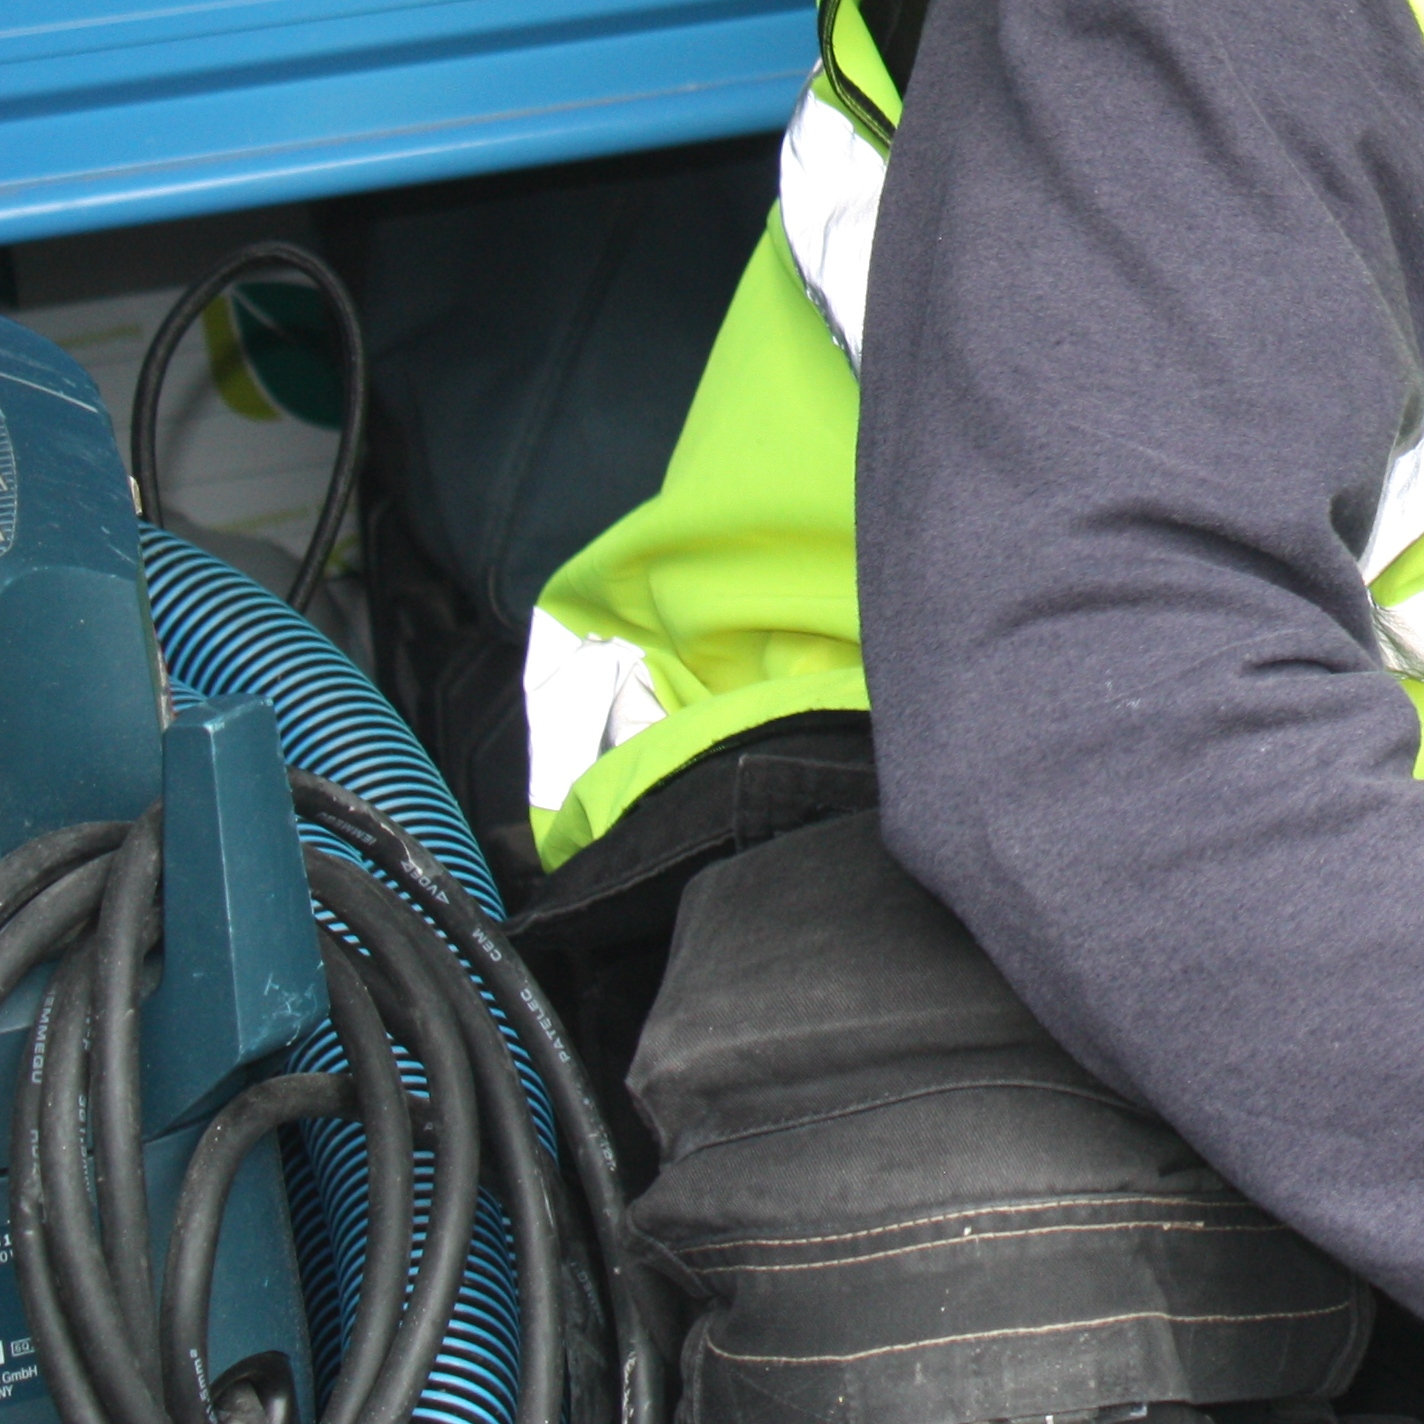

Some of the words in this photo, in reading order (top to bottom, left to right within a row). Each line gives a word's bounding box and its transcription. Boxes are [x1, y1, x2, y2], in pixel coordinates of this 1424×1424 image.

[471, 927, 503, 963] CEM
[519, 987, 572, 1064] PATELEC
[1, 1363, 39, 1384] GmbH
